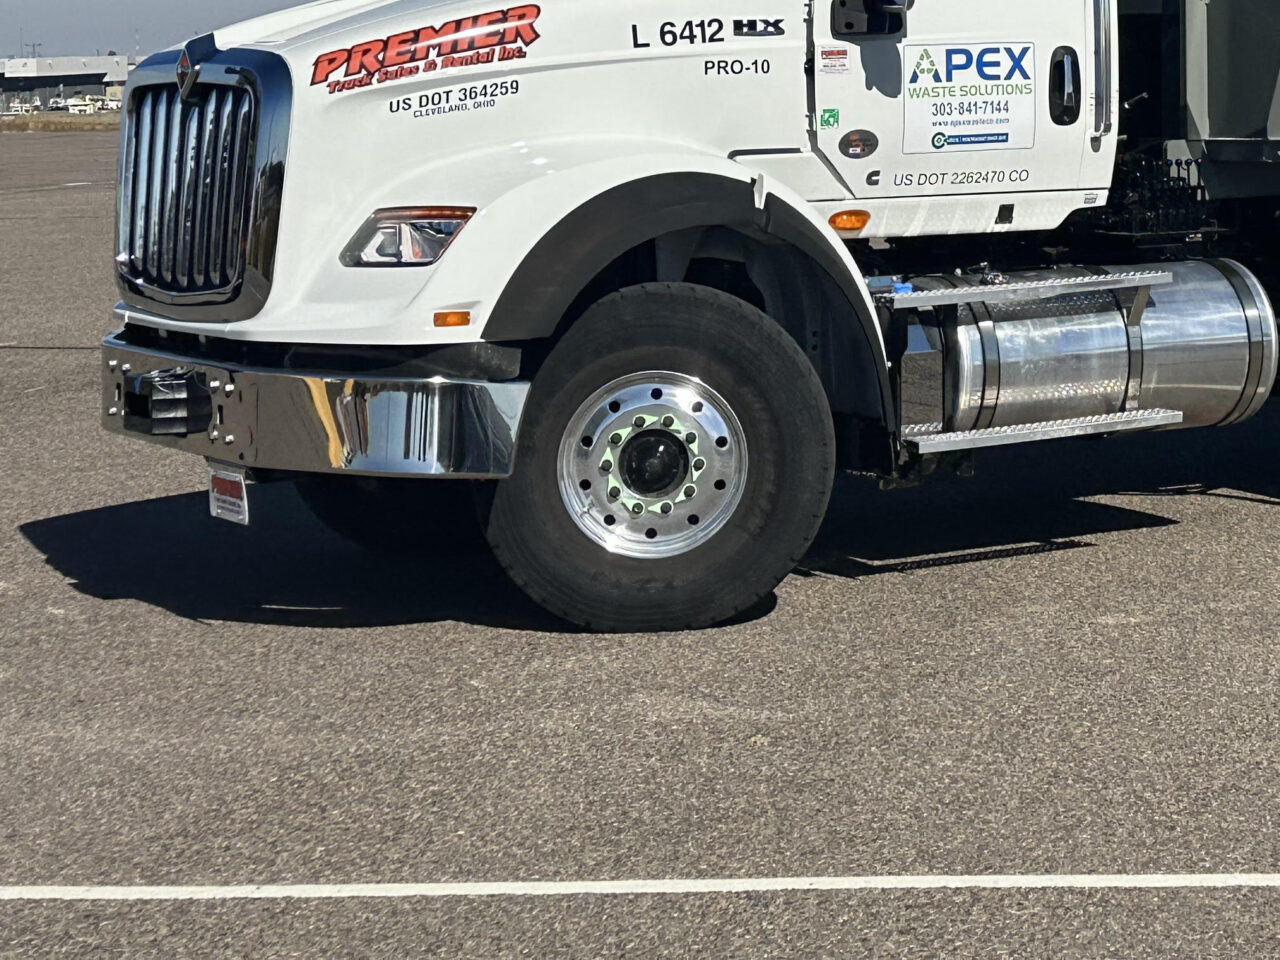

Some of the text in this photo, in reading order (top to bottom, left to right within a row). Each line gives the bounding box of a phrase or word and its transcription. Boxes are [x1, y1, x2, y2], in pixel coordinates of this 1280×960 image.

[631, 18, 725, 48] L 6412
[733, 19, 785, 36] HX
[310, 3, 541, 86] PREMIER
[327, 73, 373, 94] Truck
[377, 65, 419, 82] Sales
[441, 48, 494, 69] Rental
[498, 45, 527, 61] Inc.
[704, 59, 770, 75] PRO-10
[909, 46, 1031, 84] APEX
[389, 80, 519, 113] US DOT 364259
[908, 83, 1033, 99] WASTE SOLUTIONS
[473, 99, 496, 110] OHIO
[931, 100, 1010, 117] 303-841-7144
[893, 169, 1030, 186] US DOT 2262470 CO
